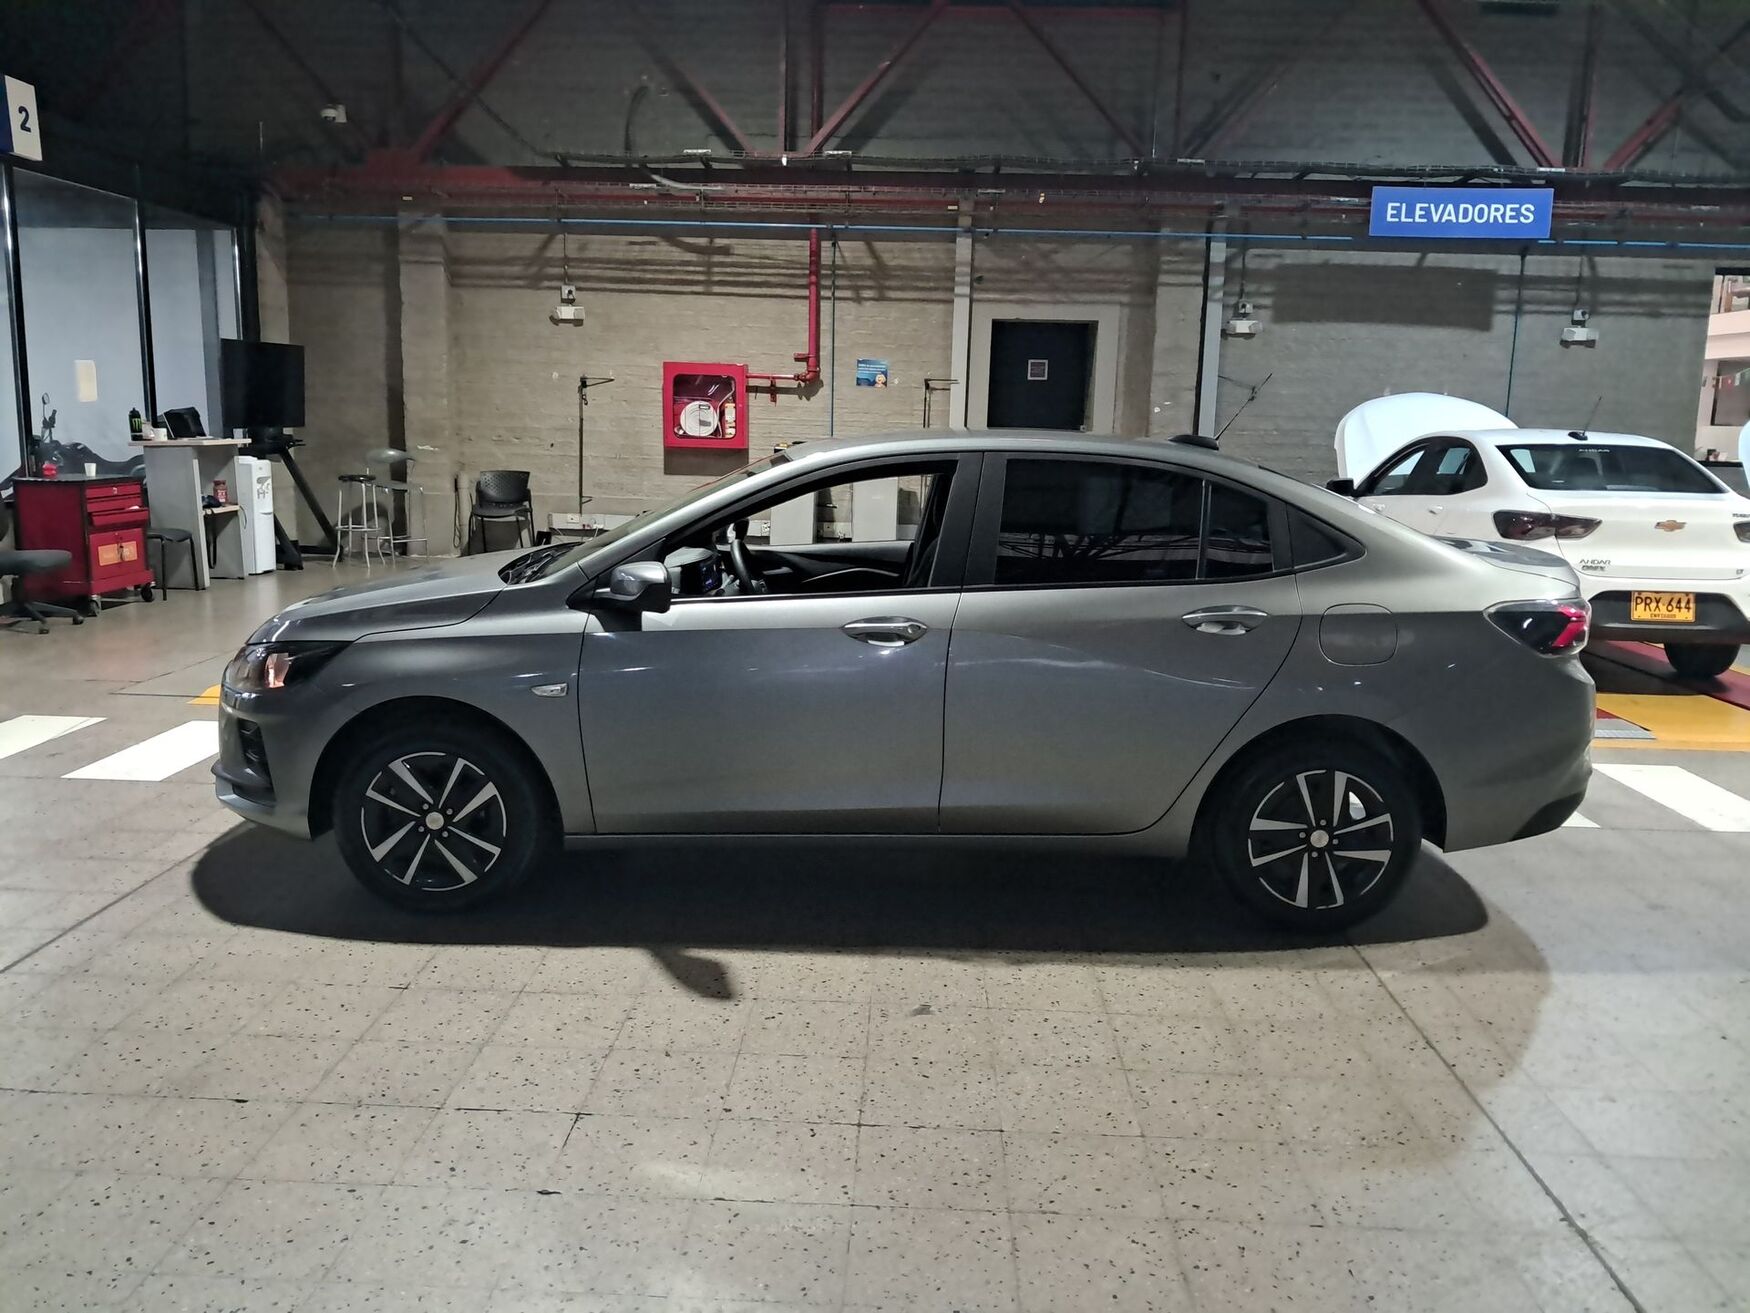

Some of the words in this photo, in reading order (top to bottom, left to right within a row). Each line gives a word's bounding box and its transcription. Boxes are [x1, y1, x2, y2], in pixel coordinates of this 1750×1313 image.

[18, 105, 32, 133] 2
[1386, 202, 1535, 224] ELEVADORES
[1634, 596, 1662, 612] PRX
[1666, 597, 1692, 613] 644
